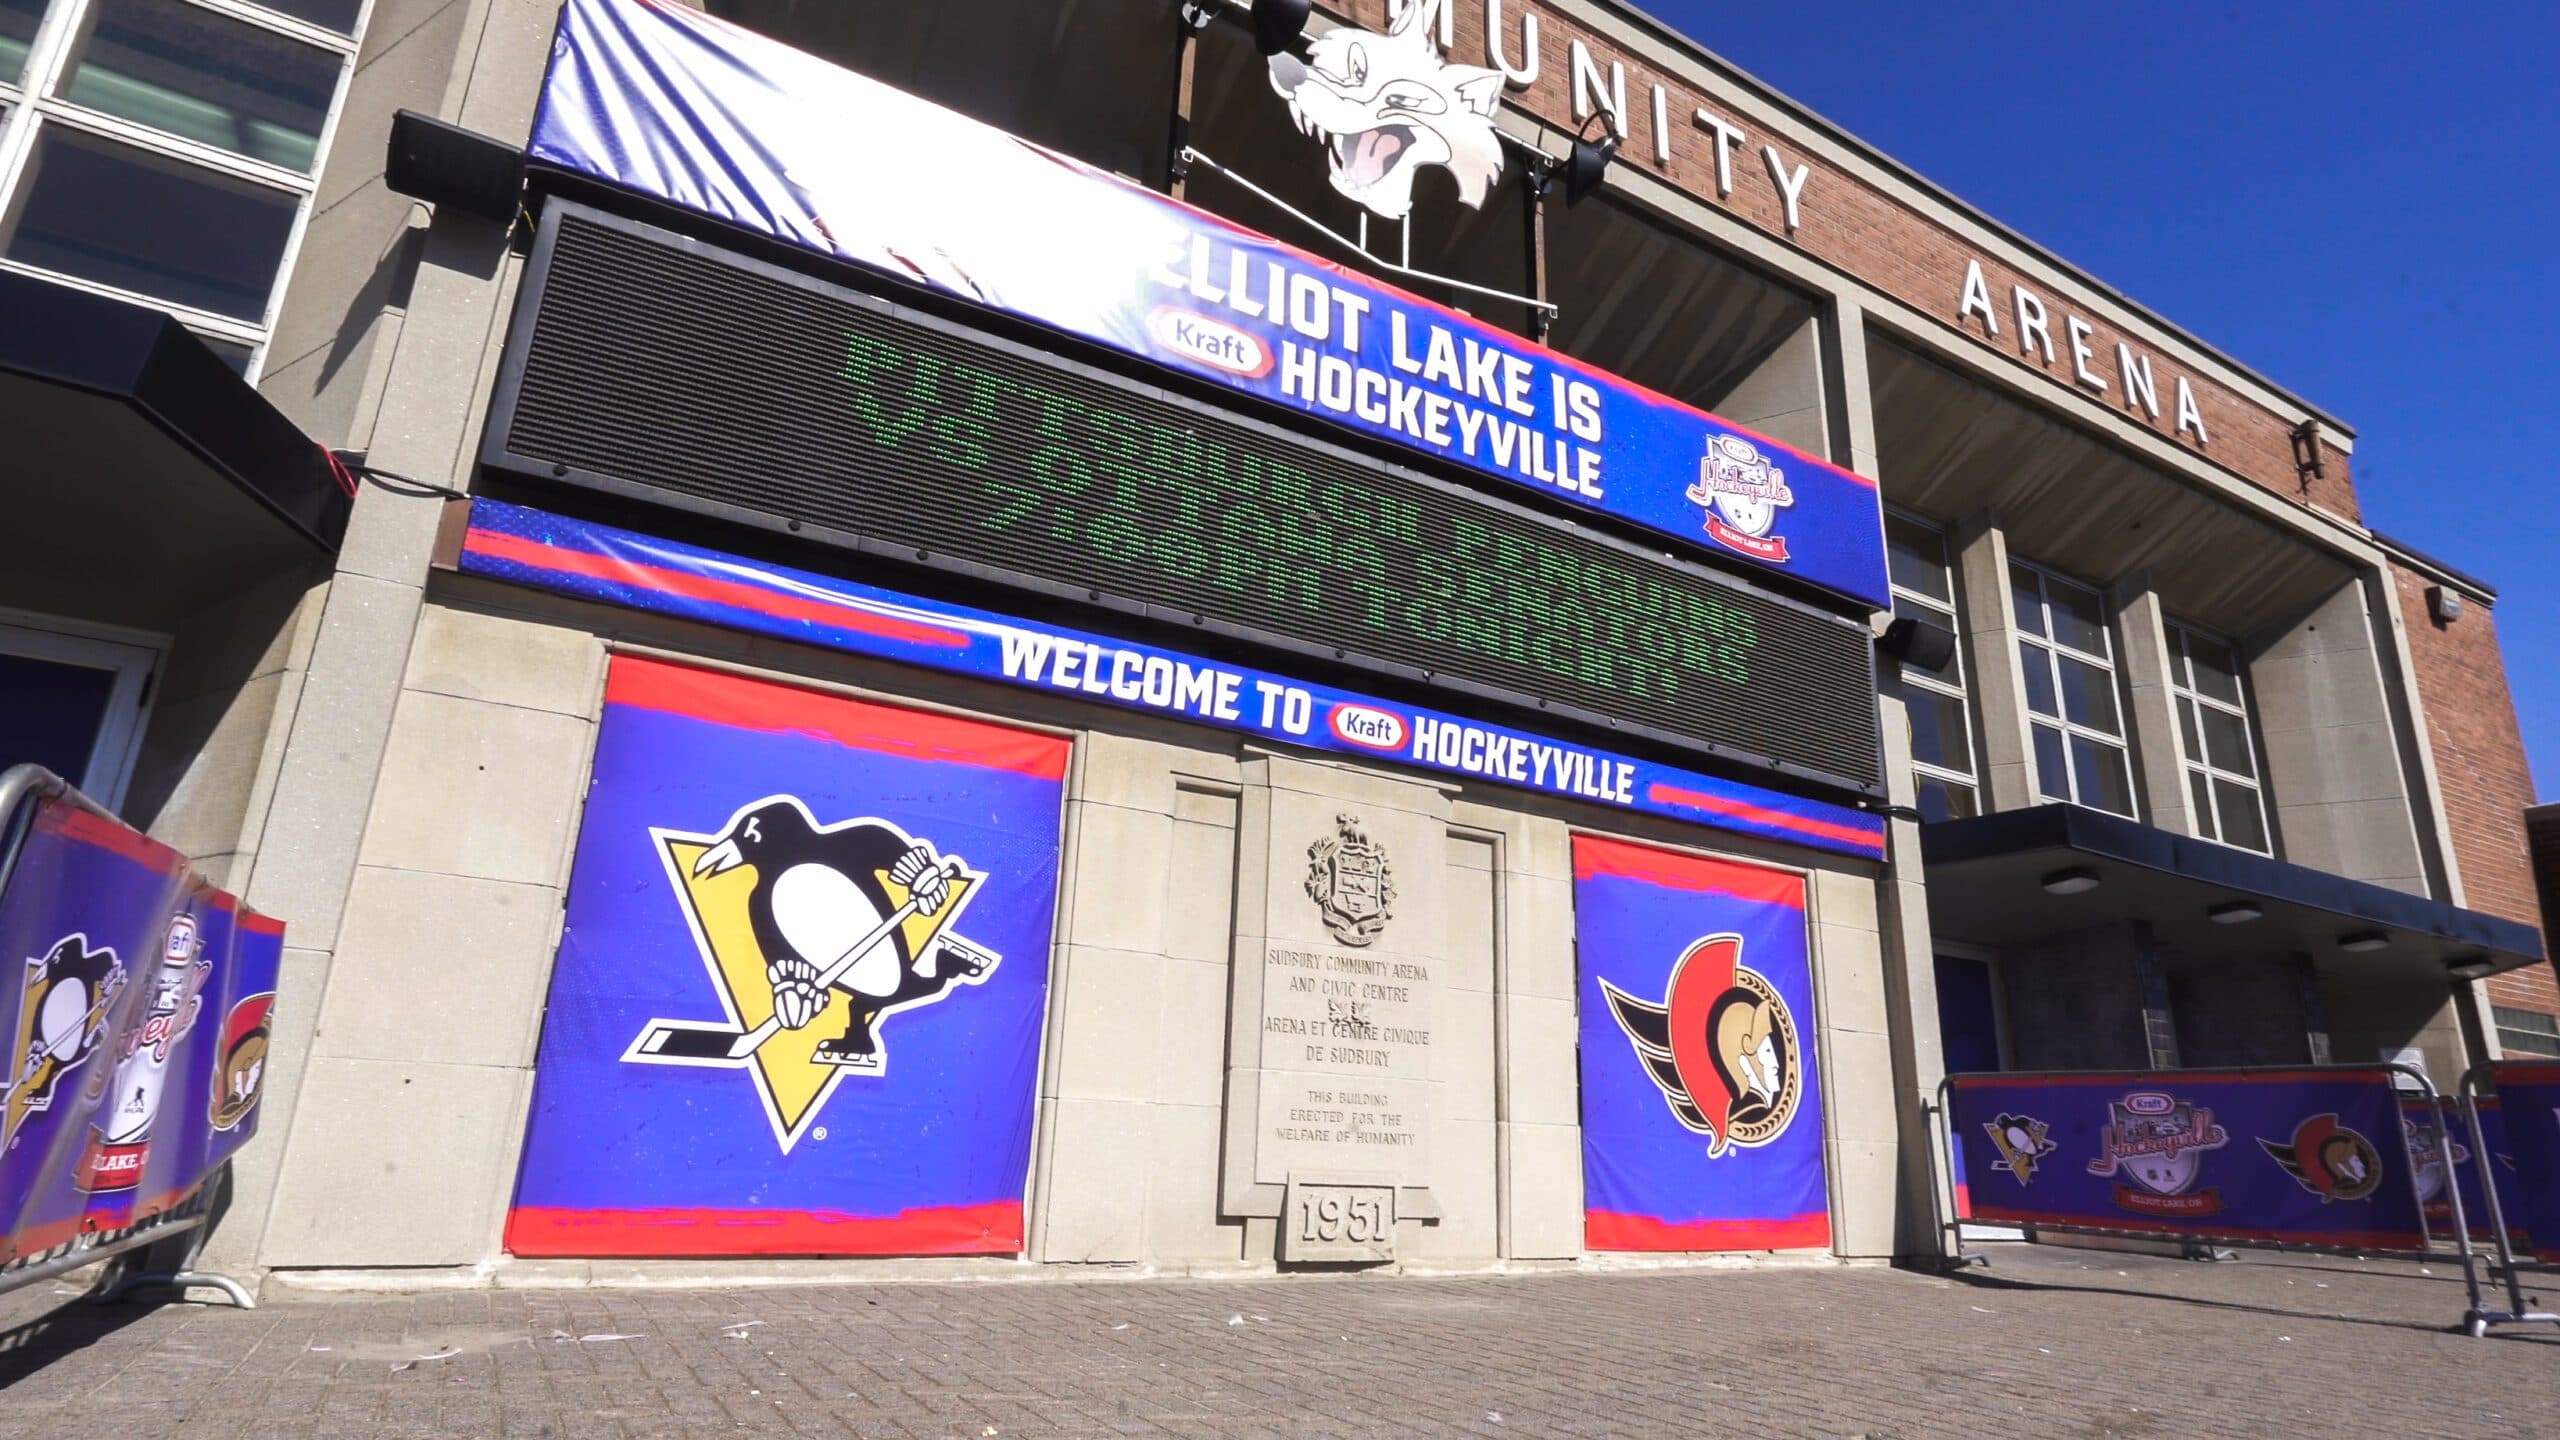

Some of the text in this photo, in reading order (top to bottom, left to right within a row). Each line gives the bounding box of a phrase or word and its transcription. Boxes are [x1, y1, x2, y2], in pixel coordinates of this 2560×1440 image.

[1150, 224, 1602, 444] ELLIOT LAKE IS
[1176, 318, 1245, 364] Kraft
[1958, 258, 2209, 444] ARENA
[1280, 340, 1604, 500] HOCKEYVILLE
[837, 332, 1758, 648] PITTSBURGH PENGUINS
[854, 391, 1749, 685] VS OTTAWA SENATORS
[980, 481, 1321, 611] 7:00PM
[999, 625, 1636, 805] WELCOME TO Kraft HOCKEYVILLE
[1268, 949, 1428, 981] SUDBURY COMMUNITY ARENA
[1289, 976, 1409, 1002] AND CIVIC CENTRE
[1264, 1016, 1430, 1045] ARENA ET CENTRE CIVIQUE
[1306, 1045, 1391, 1067] DE SUDBURY
[1290, 1109, 1402, 1127] ERECTED FOR THE
[1307, 1090, 1388, 1107] THIS BUILDING
[2136, 1099, 2163, 1110] Kraft
[1275, 1127, 1416, 1146] WELFARE OF HUMANITY
[2091, 1109, 2223, 1169] Hockeyville
[1302, 1194, 1386, 1243] 1951
